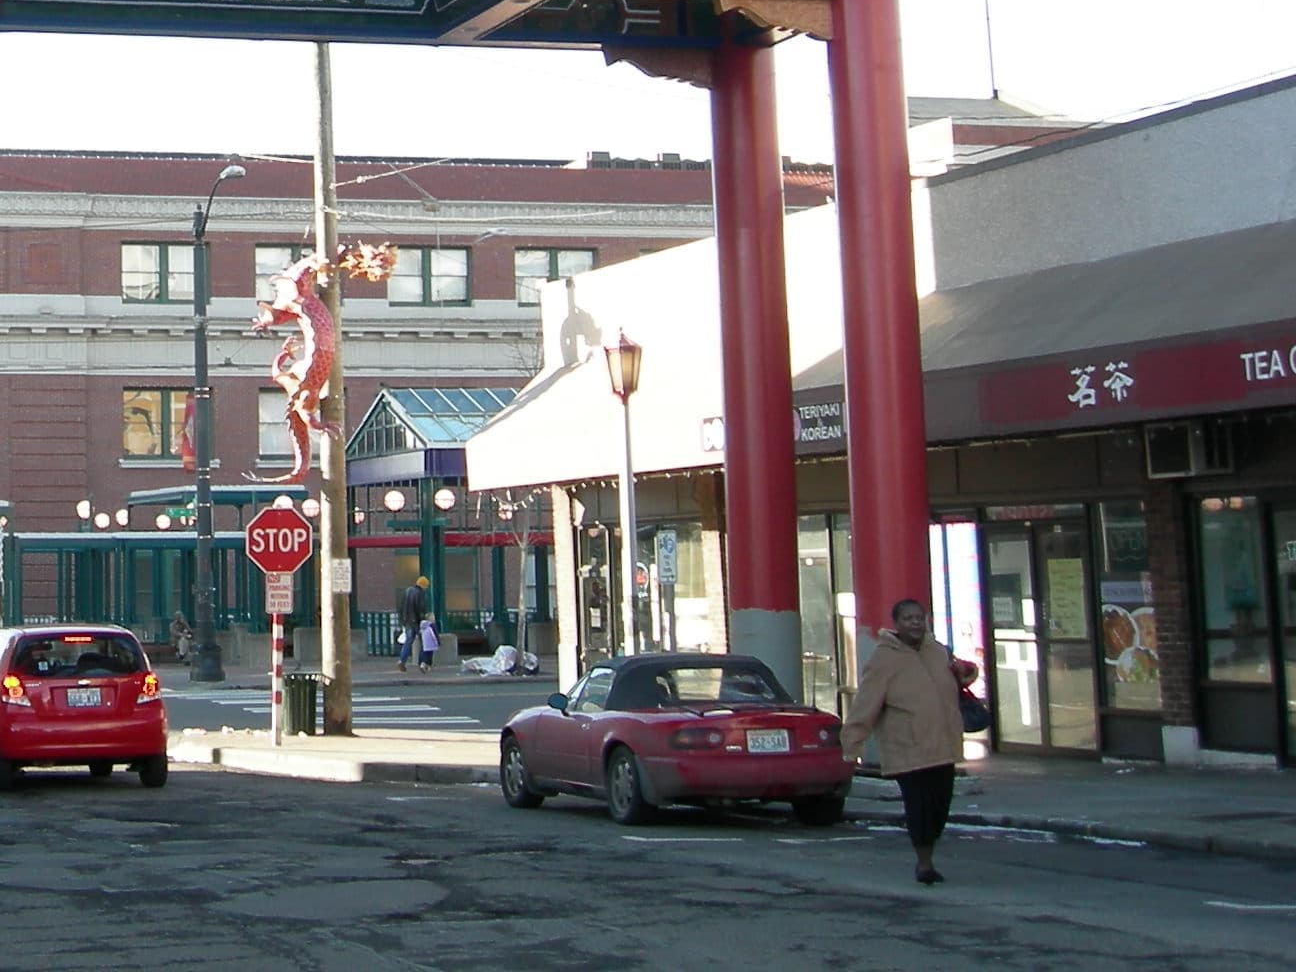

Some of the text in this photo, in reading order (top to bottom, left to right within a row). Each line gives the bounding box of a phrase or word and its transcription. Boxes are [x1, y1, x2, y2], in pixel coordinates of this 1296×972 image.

[1240, 350, 1285, 381] TEA
[799, 403, 839, 419] TERIYAKI
[801, 425, 842, 441] KOREAN
[252, 528, 307, 553] STOP
